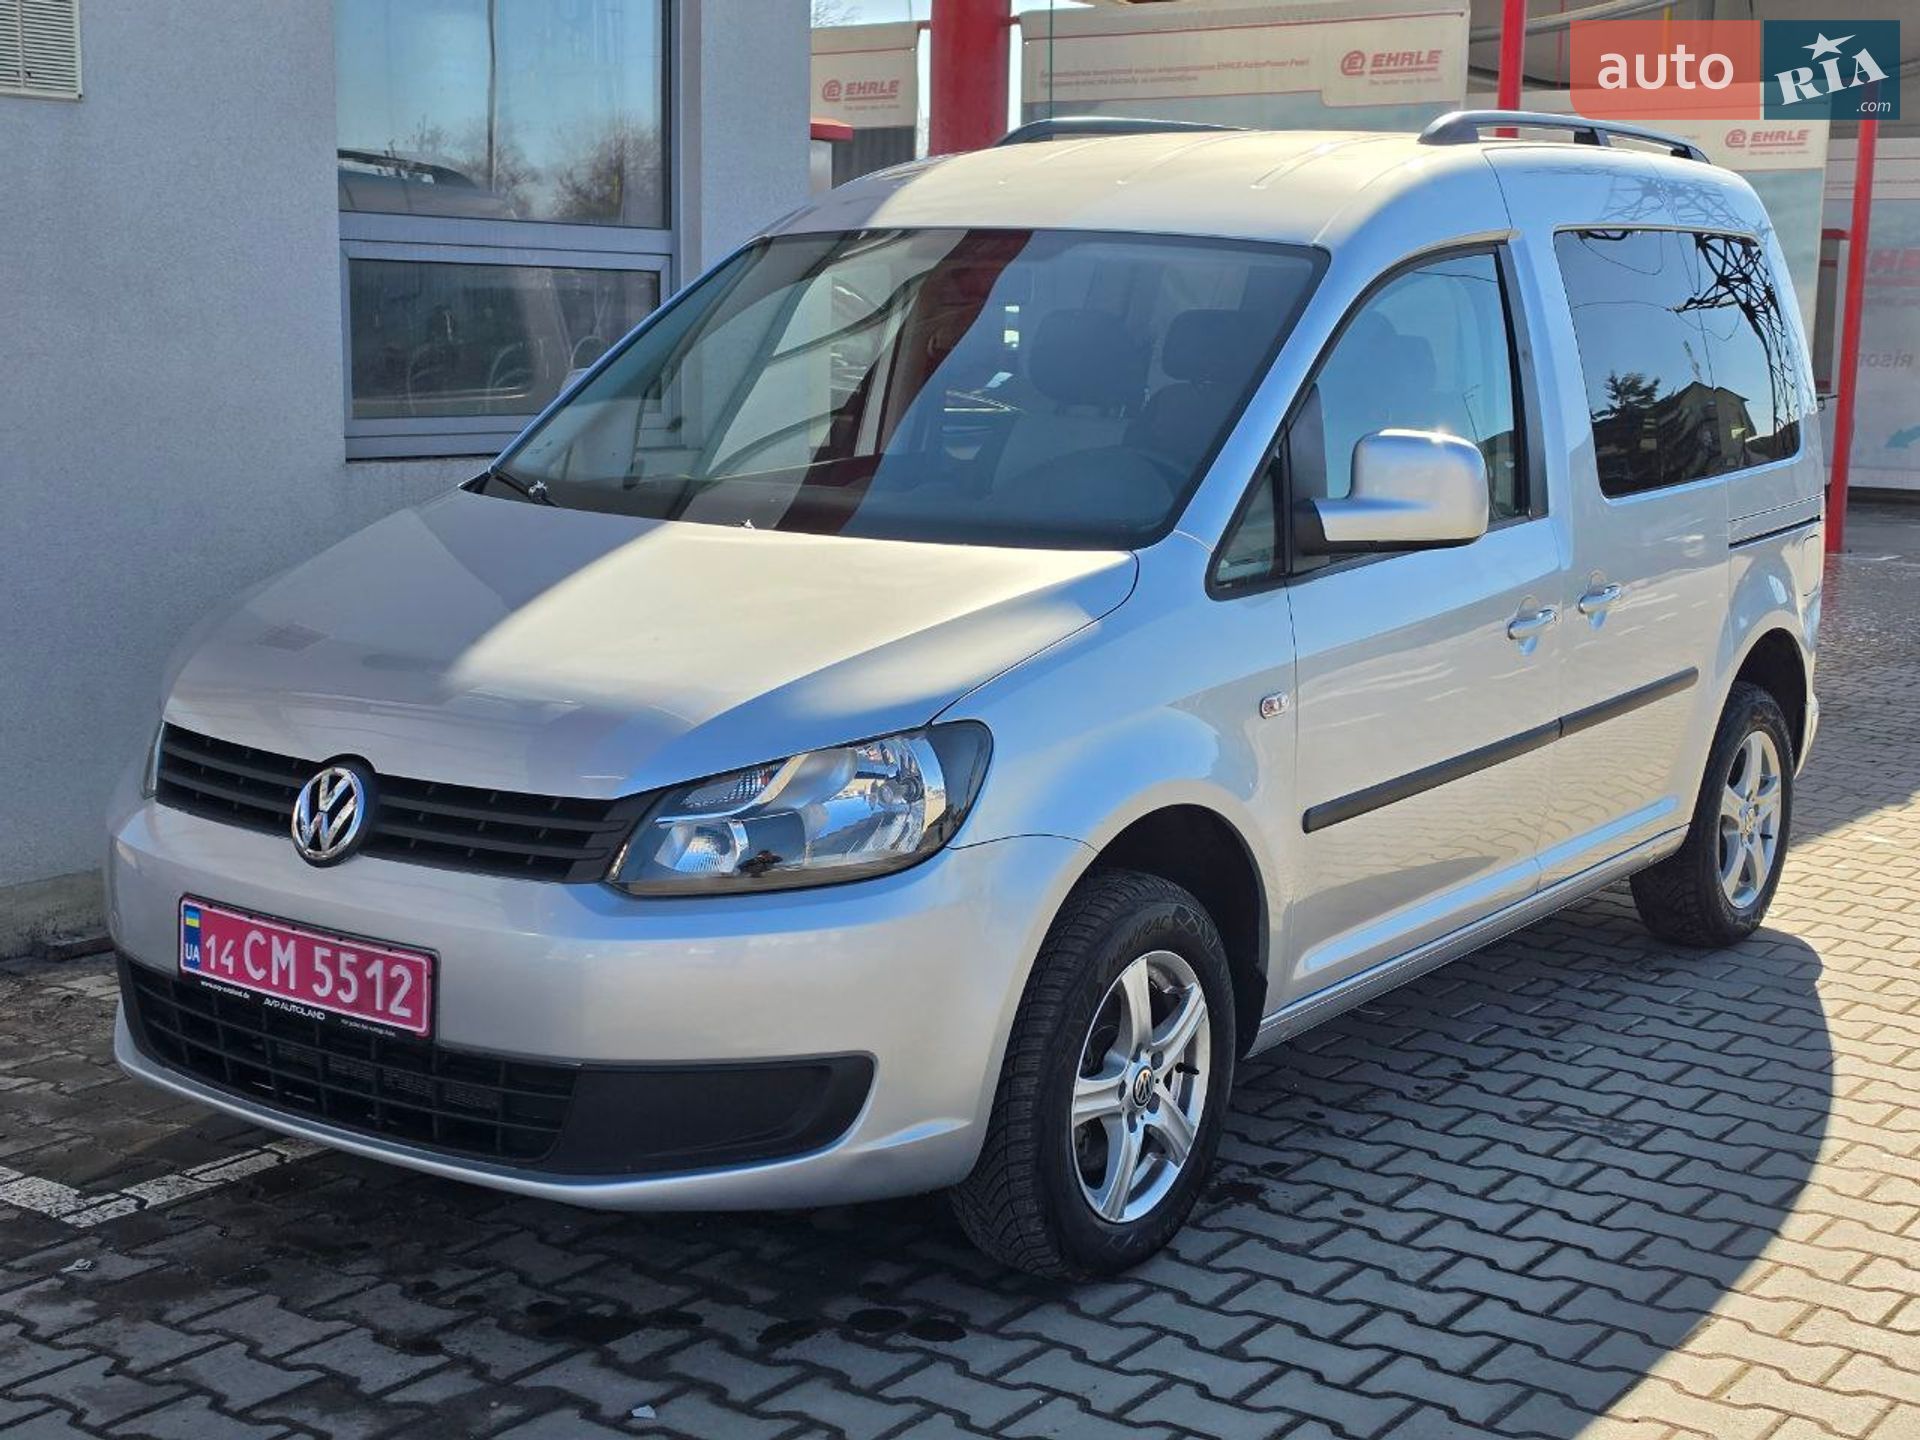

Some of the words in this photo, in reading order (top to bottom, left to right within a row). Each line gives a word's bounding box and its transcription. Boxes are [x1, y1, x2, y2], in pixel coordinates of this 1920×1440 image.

[1371, 50, 1442, 68] EHRLE
[844, 80, 900, 96] EHRLE
[1750, 129, 1810, 143] EHRLE
[185, 943, 200, 963] UA
[312, 946, 413, 1019] 5512
[280, 1002, 326, 1020] AUTOLAND
